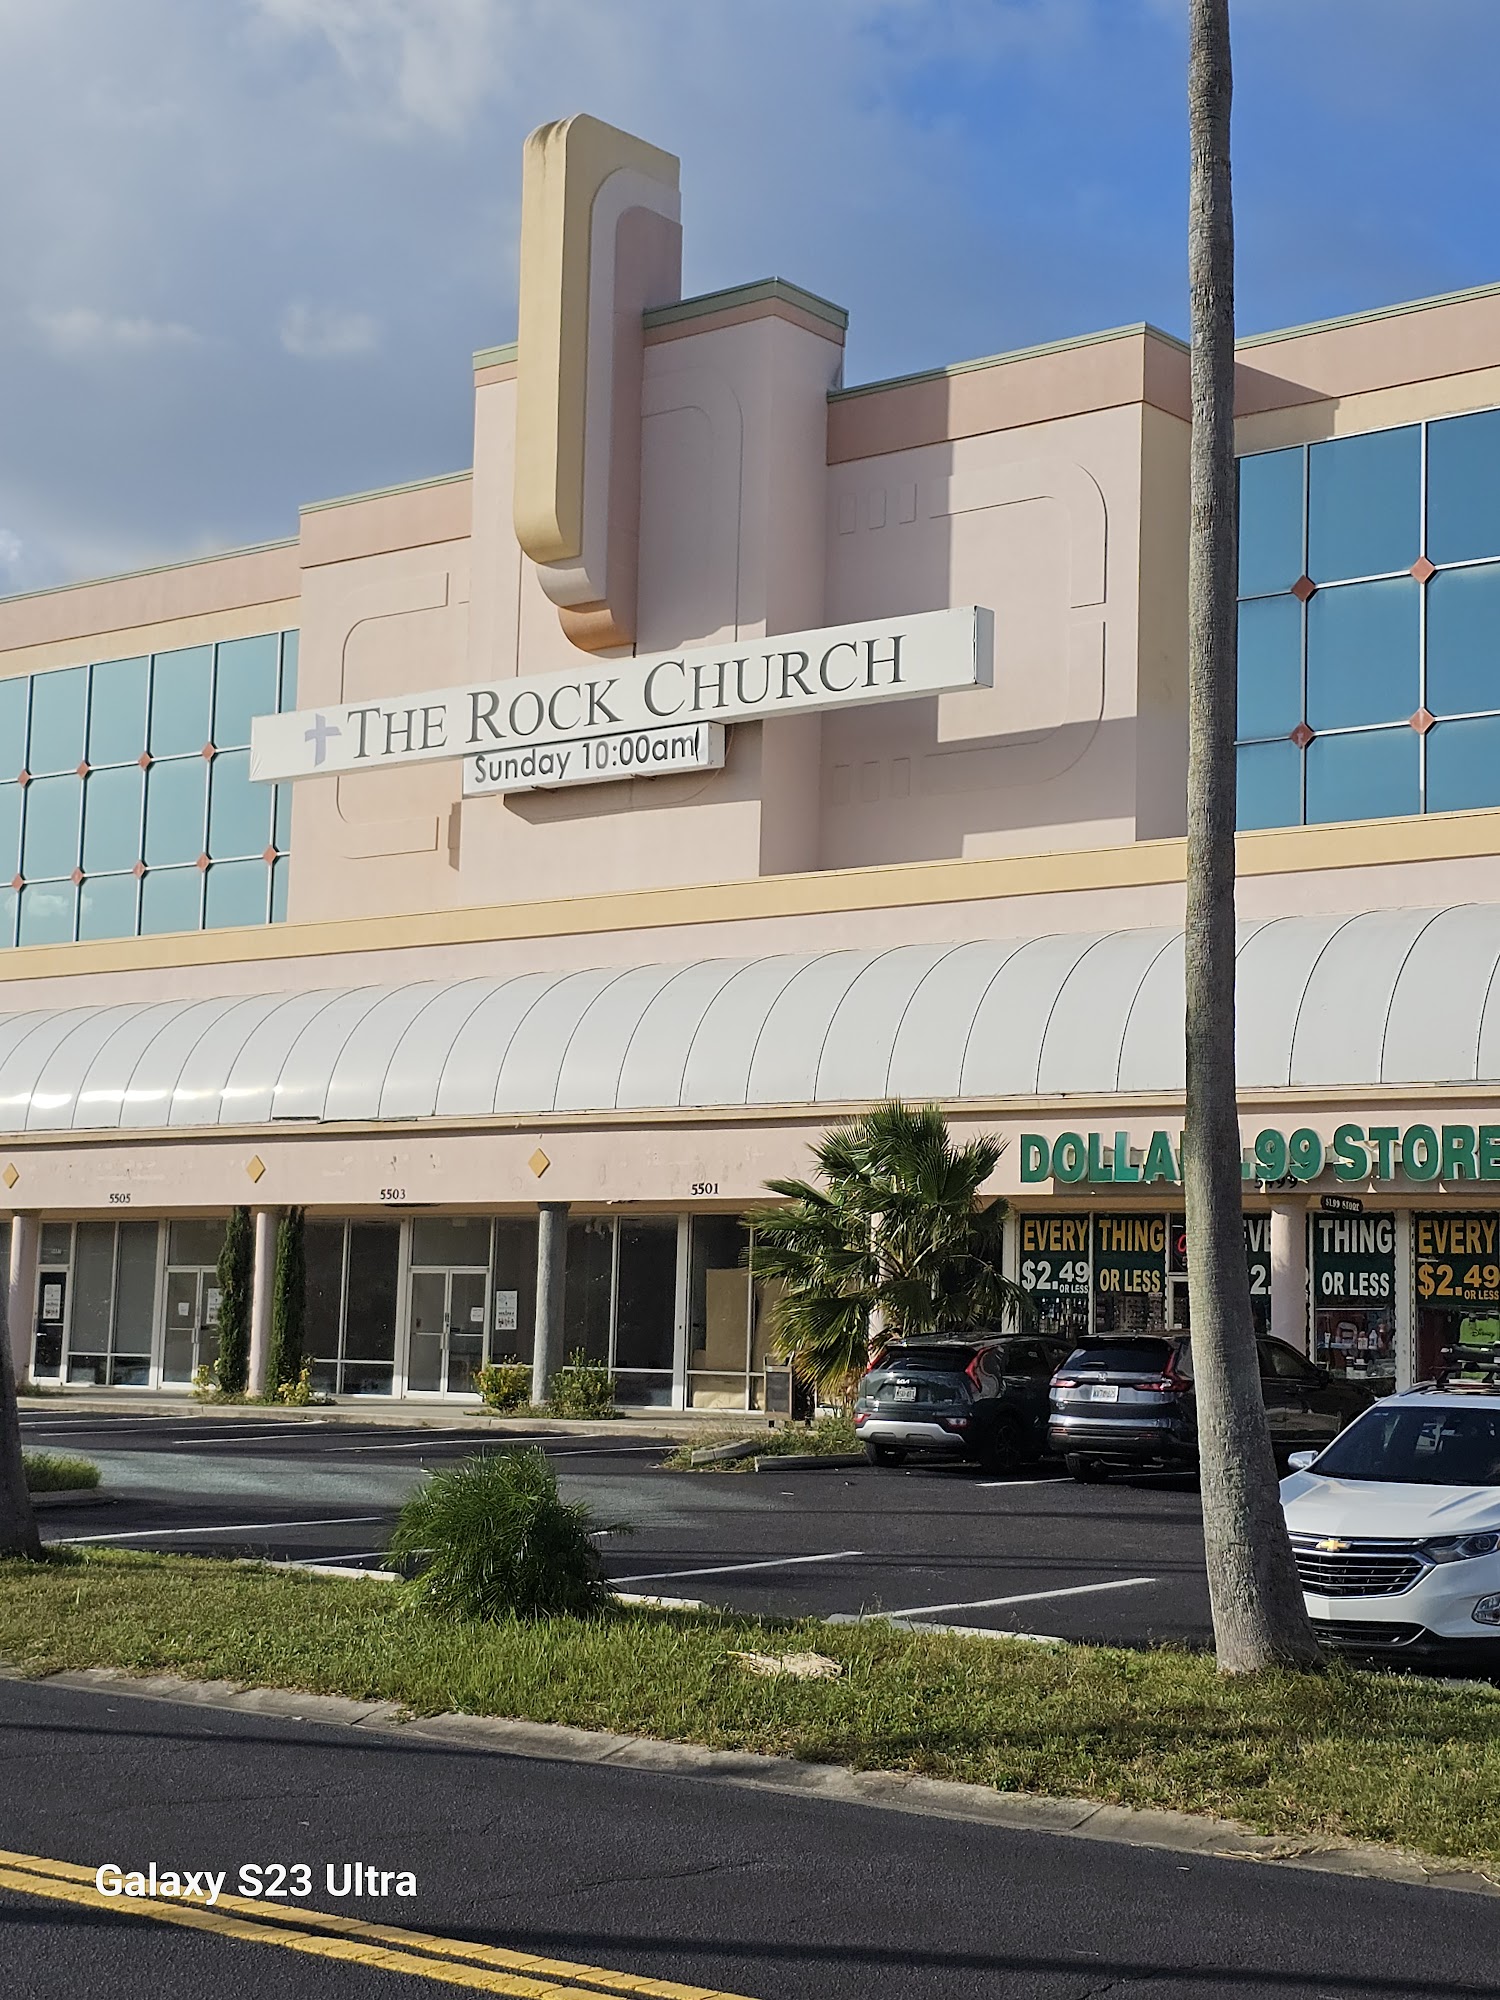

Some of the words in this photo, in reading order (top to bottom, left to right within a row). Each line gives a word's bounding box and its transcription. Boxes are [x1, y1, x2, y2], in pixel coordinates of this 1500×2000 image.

[347, 705, 448, 759] THE
[465, 678, 624, 743] ROCK
[643, 634, 907, 716] CHURCH
[474, 748, 571, 783] Sunday
[582, 734, 695, 769] 10:00am
[1020, 1131, 1185, 1183] DOLLA
[1333, 1123, 1500, 1182] STORE
[109, 1193, 131, 1204] 5505
[380, 1188, 406, 1200] 5503
[691, 1183, 719, 1196] 5501
[1342, 1200, 1360, 1211] STORE
[1023, 1219, 1088, 1251] EVERY
[1099, 1219, 1164, 1252] THING
[1319, 1219, 1393, 1254] THING
[1418, 1219, 1498, 1254] EVERY
[1021, 1259, 1090, 1293] $2.49
[1059, 1284, 1070, 1294] OR
[1071, 1284, 1089, 1294] LESS
[1100, 1269, 1121, 1292] OR
[1124, 1269, 1161, 1293] LESS
[1322, 1271, 1345, 1295] OR
[1349, 1272, 1390, 1297] LESS
[1417, 1262, 1500, 1299] $2.49
[1464, 1290, 1477, 1300] OR
[1478, 1290, 1499, 1300] LESS
